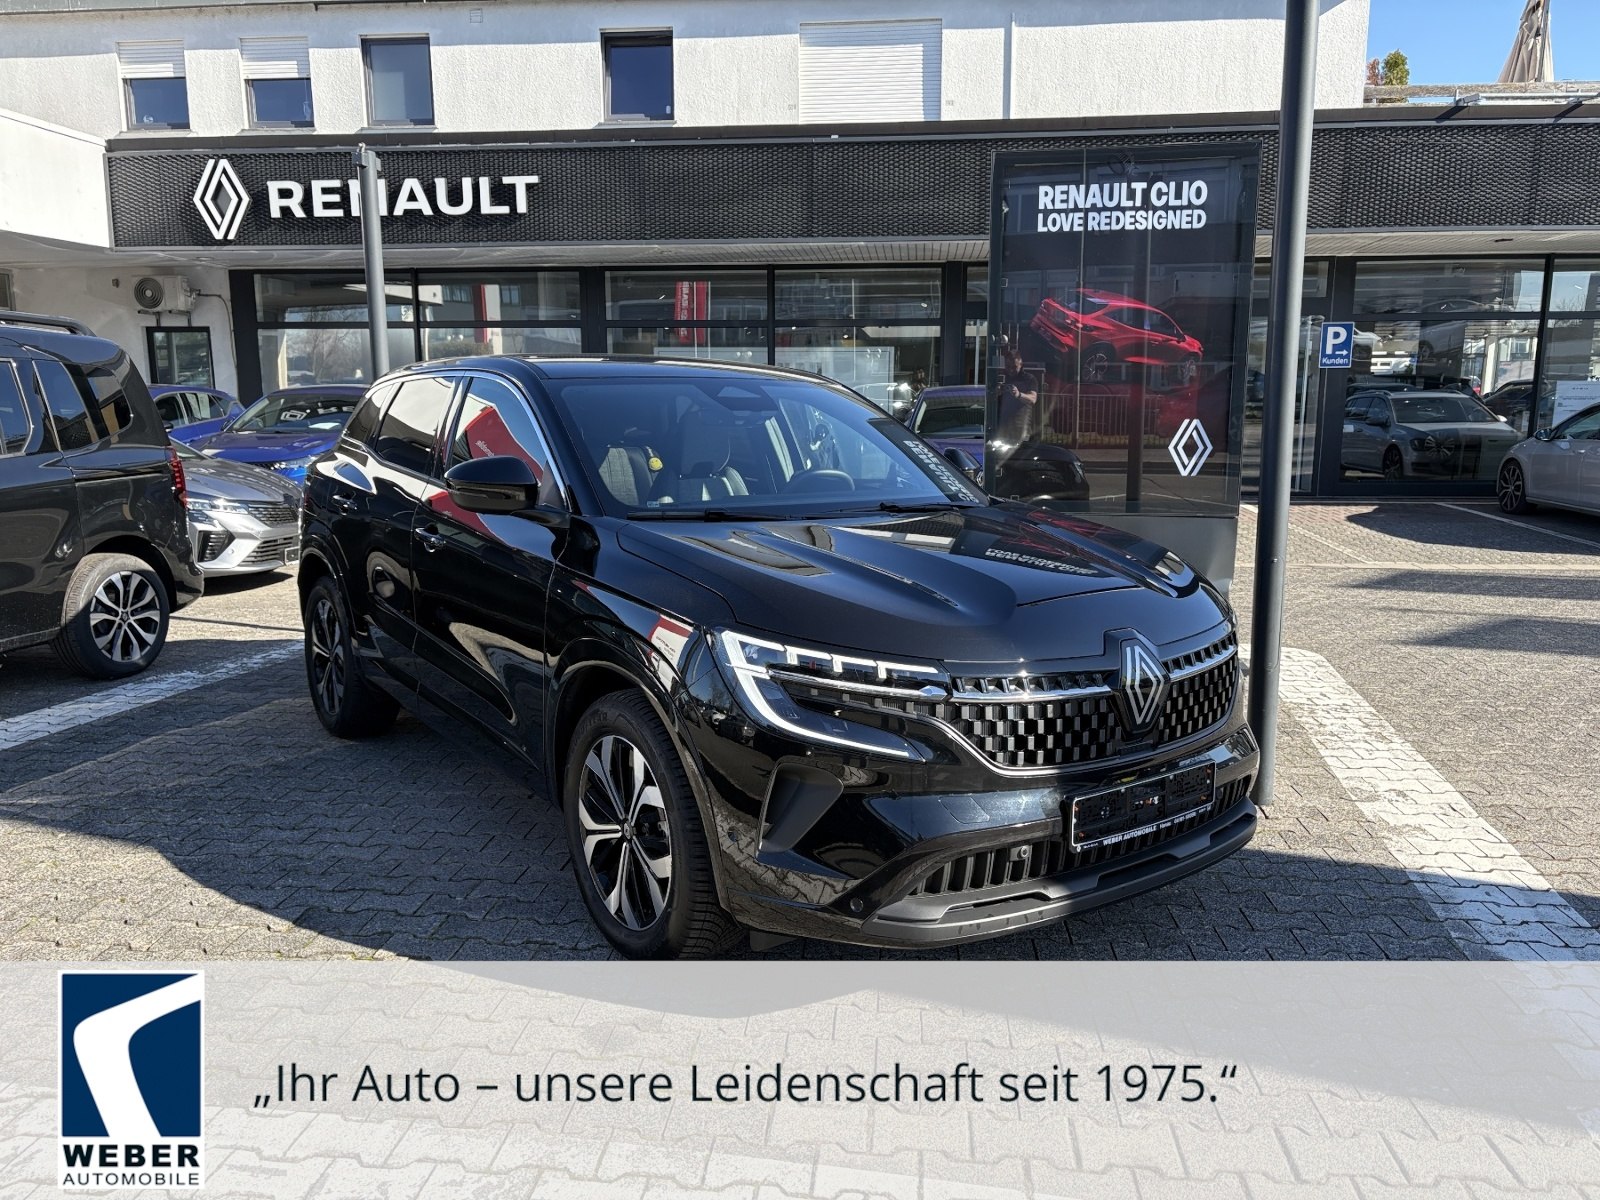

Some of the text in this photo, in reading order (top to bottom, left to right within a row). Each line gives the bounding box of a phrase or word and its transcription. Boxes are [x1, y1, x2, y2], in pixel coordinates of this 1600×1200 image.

[1038, 180, 1208, 210] RENAULT CLIO
[1037, 209, 1207, 233] LOVE REDESIGNED
[1325, 326, 1348, 355] P
[1322, 357, 1349, 365] Kunden
[1103, 835, 1123, 846] WEBER
